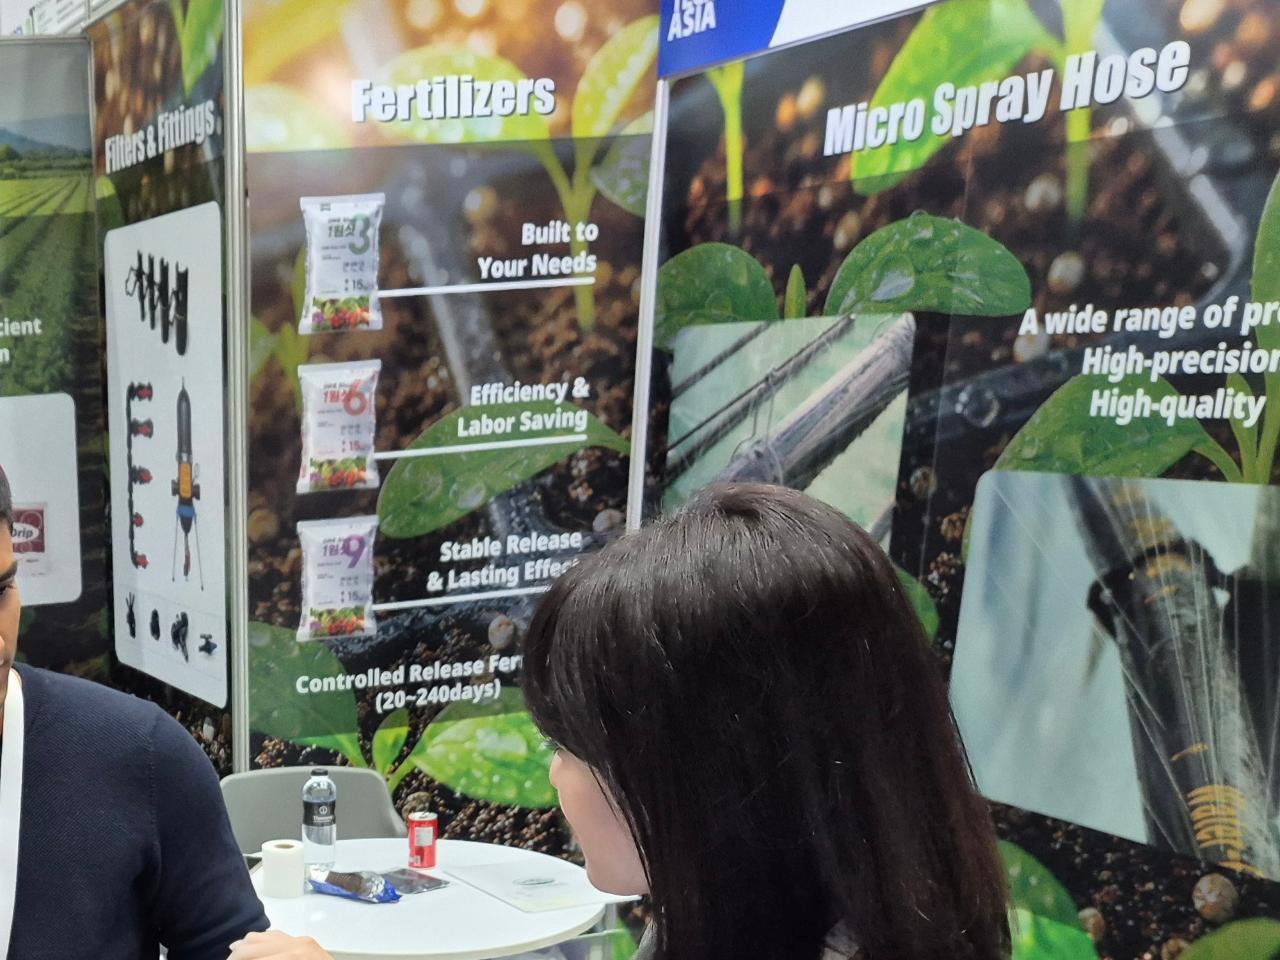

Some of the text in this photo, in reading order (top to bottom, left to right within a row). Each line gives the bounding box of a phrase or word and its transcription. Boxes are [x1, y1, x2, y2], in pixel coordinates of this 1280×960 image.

[667, 2, 717, 42] ASIA
[351, 74, 556, 122] Fertilizers
[823, 40, 1191, 157] Micro Spray Hose
[105, 100, 215, 175] Filters & Fittings
[522, 220, 599, 247] Built to
[478, 252, 598, 281] Your Needs
[1018, 295, 1280, 339] A wide range of pr
[470, 376, 590, 407] Efficiency &
[1089, 387, 1267, 429] High-quality
[457, 406, 588, 438] Labor Saving
[440, 531, 583, 562] Stable Release
[426, 572, 444, 592] &
[448, 564, 517, 590] Lasting
[296, 668, 404, 694] Controlled
[409, 660, 484, 688] Release
[375, 679, 502, 714] (20~240days)
